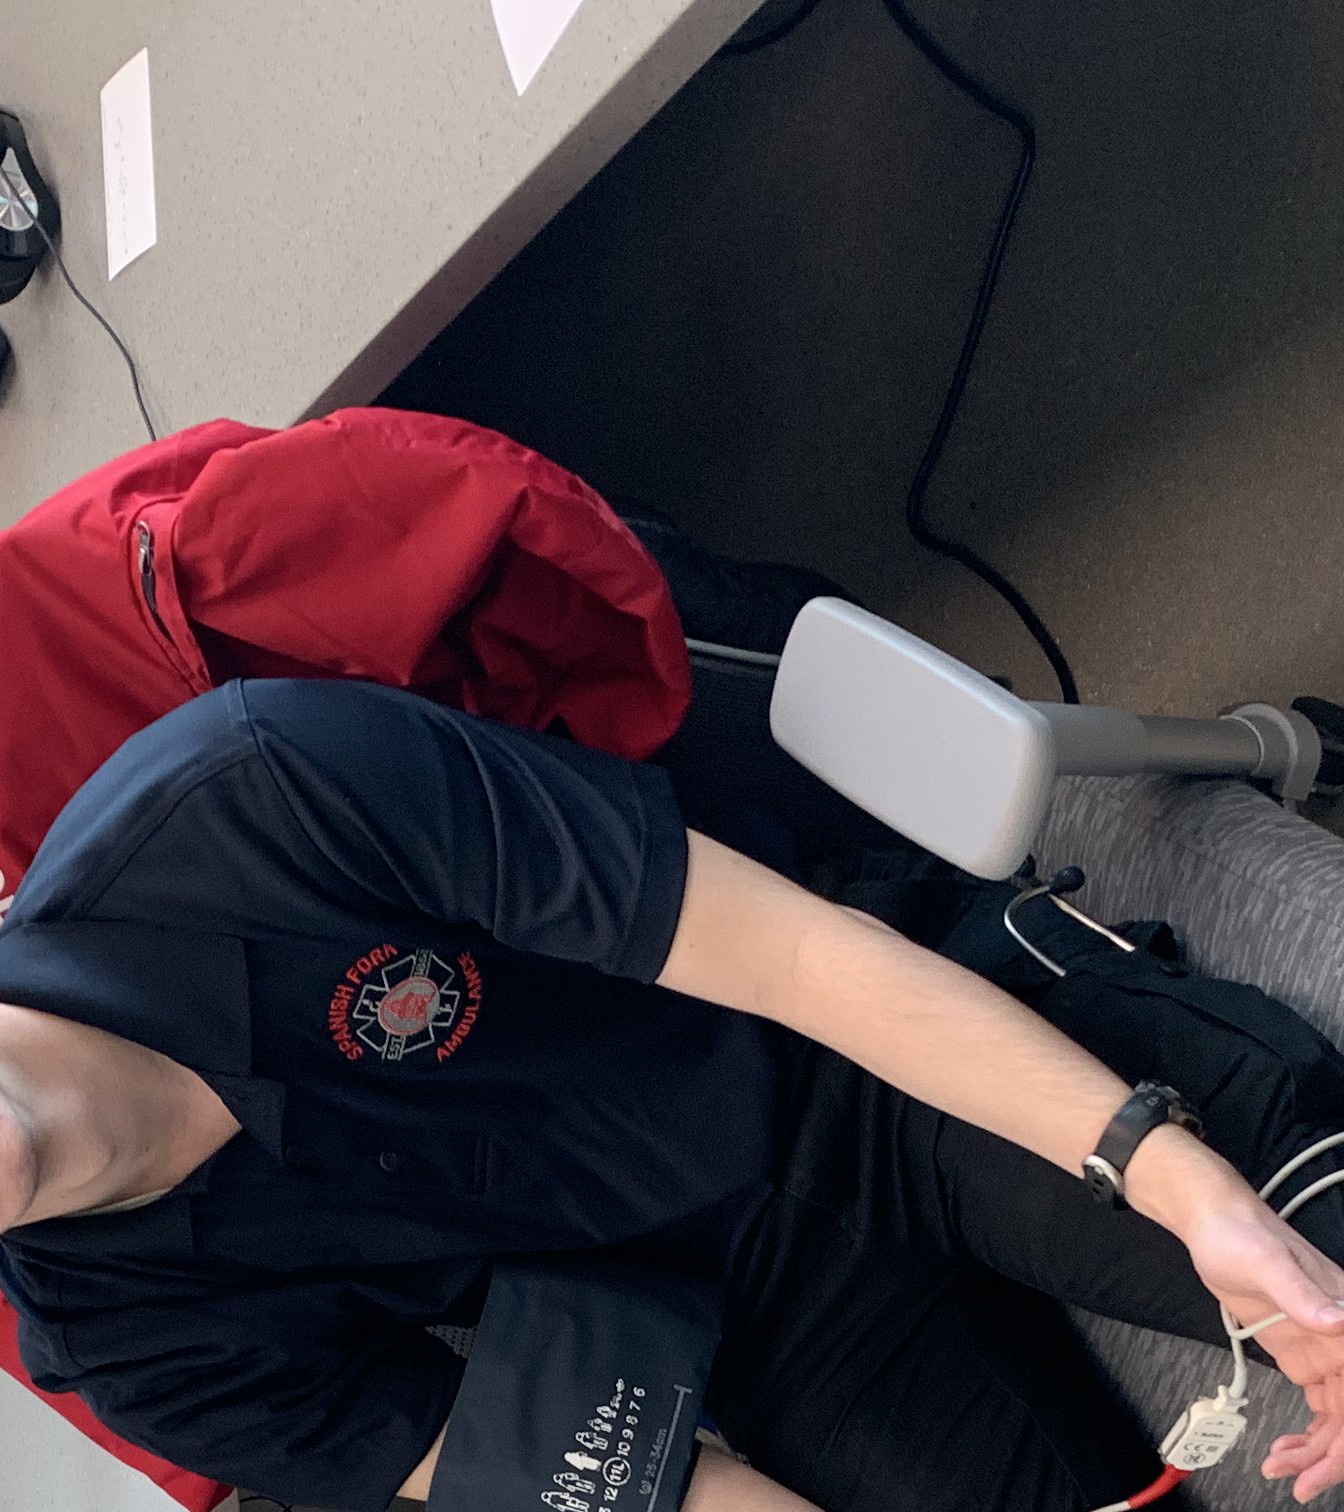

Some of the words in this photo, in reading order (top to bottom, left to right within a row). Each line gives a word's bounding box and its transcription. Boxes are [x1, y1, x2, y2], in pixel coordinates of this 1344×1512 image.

[327, 984, 365, 1061] SPANISH
[346, 943, 399, 985] FORK
[436, 950, 483, 1063] AMBULANCE
[633, 1386, 646, 1398] 6
[629, 1400, 642, 1412] 7
[625, 1414, 639, 1426] 8
[622, 1428, 635, 1441] 9
[616, 1441, 632, 1457] 10
[609, 1462, 625, 1483] 11L
[603, 1486, 619, 1501] 12
